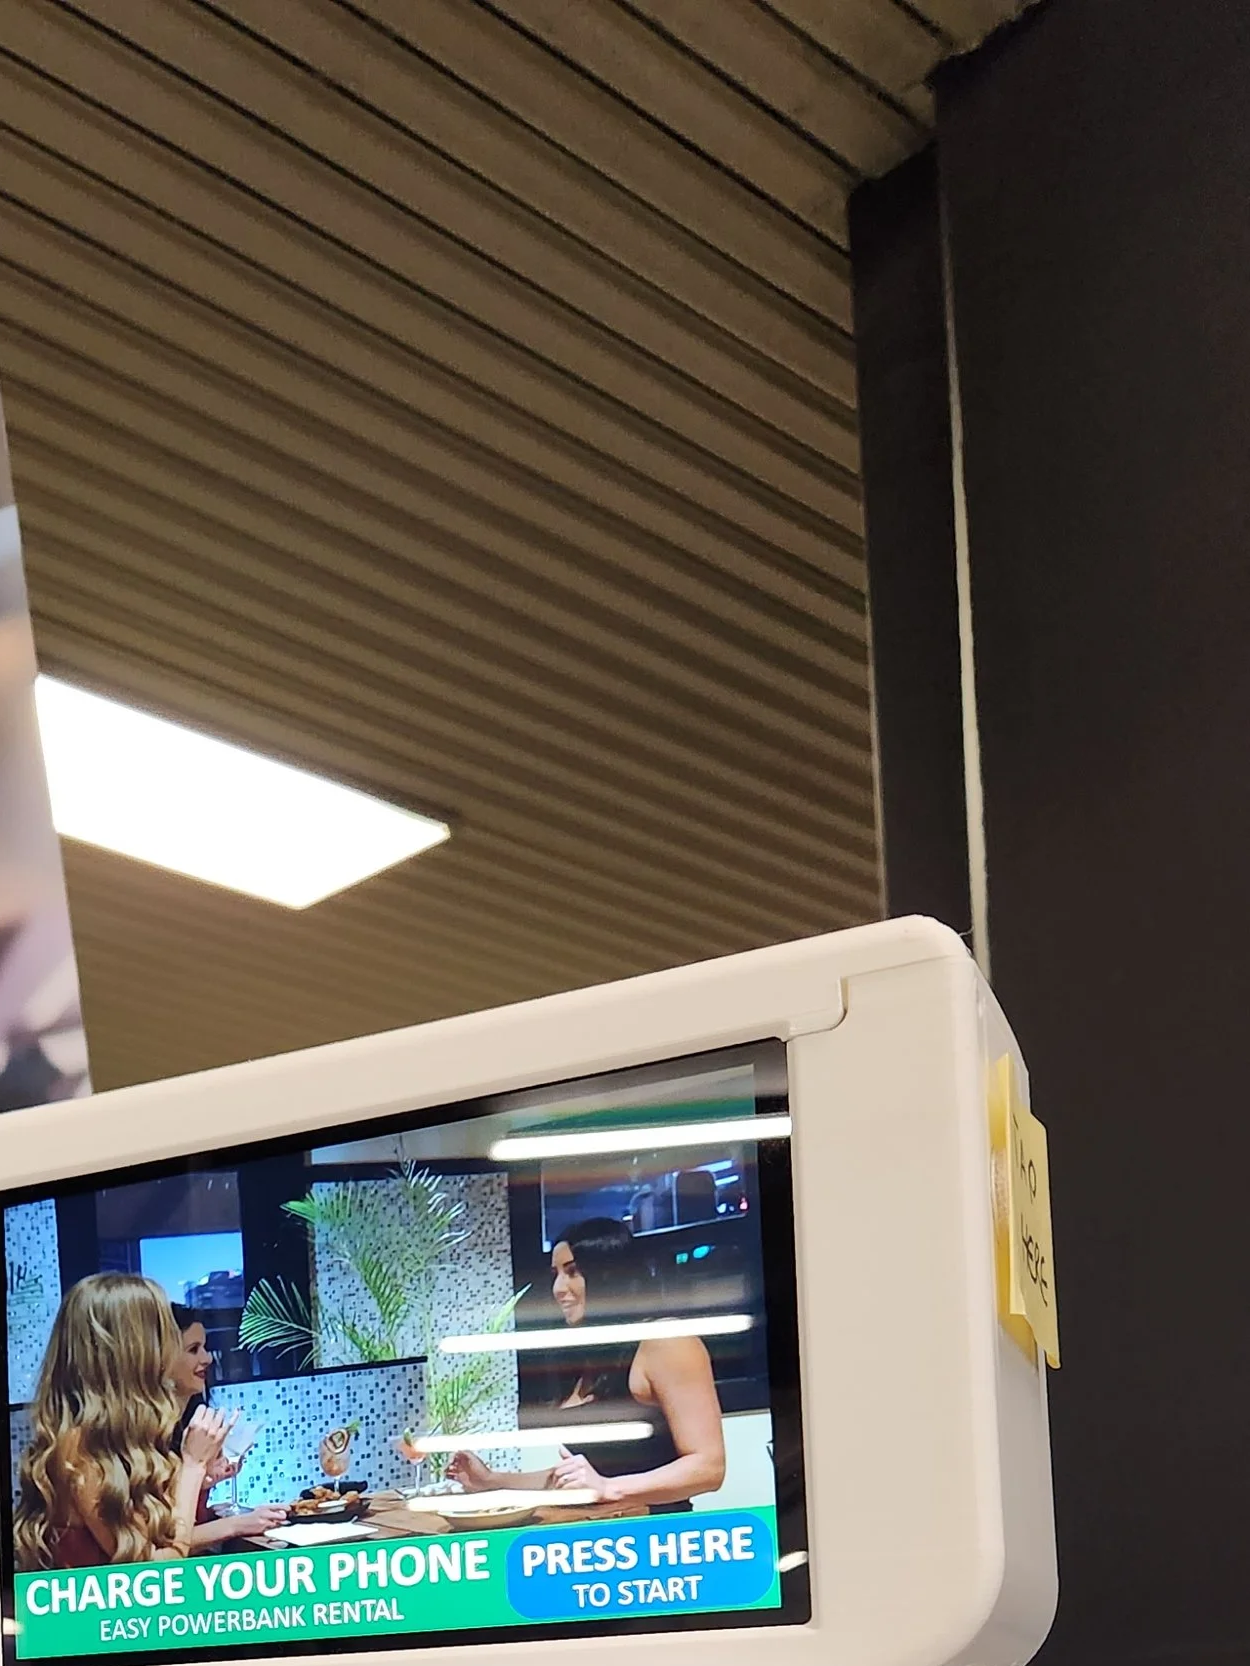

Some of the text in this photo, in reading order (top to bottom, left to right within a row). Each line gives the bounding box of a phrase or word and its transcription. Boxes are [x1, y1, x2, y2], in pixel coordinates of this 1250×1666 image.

[521, 1525, 756, 1578] PRESS HERE
[25, 1538, 491, 1617] CHARGE YOUR PHONE
[571, 1574, 704, 1609] TO START
[99, 1596, 405, 1643] EASY POWERBANK RENTAL
